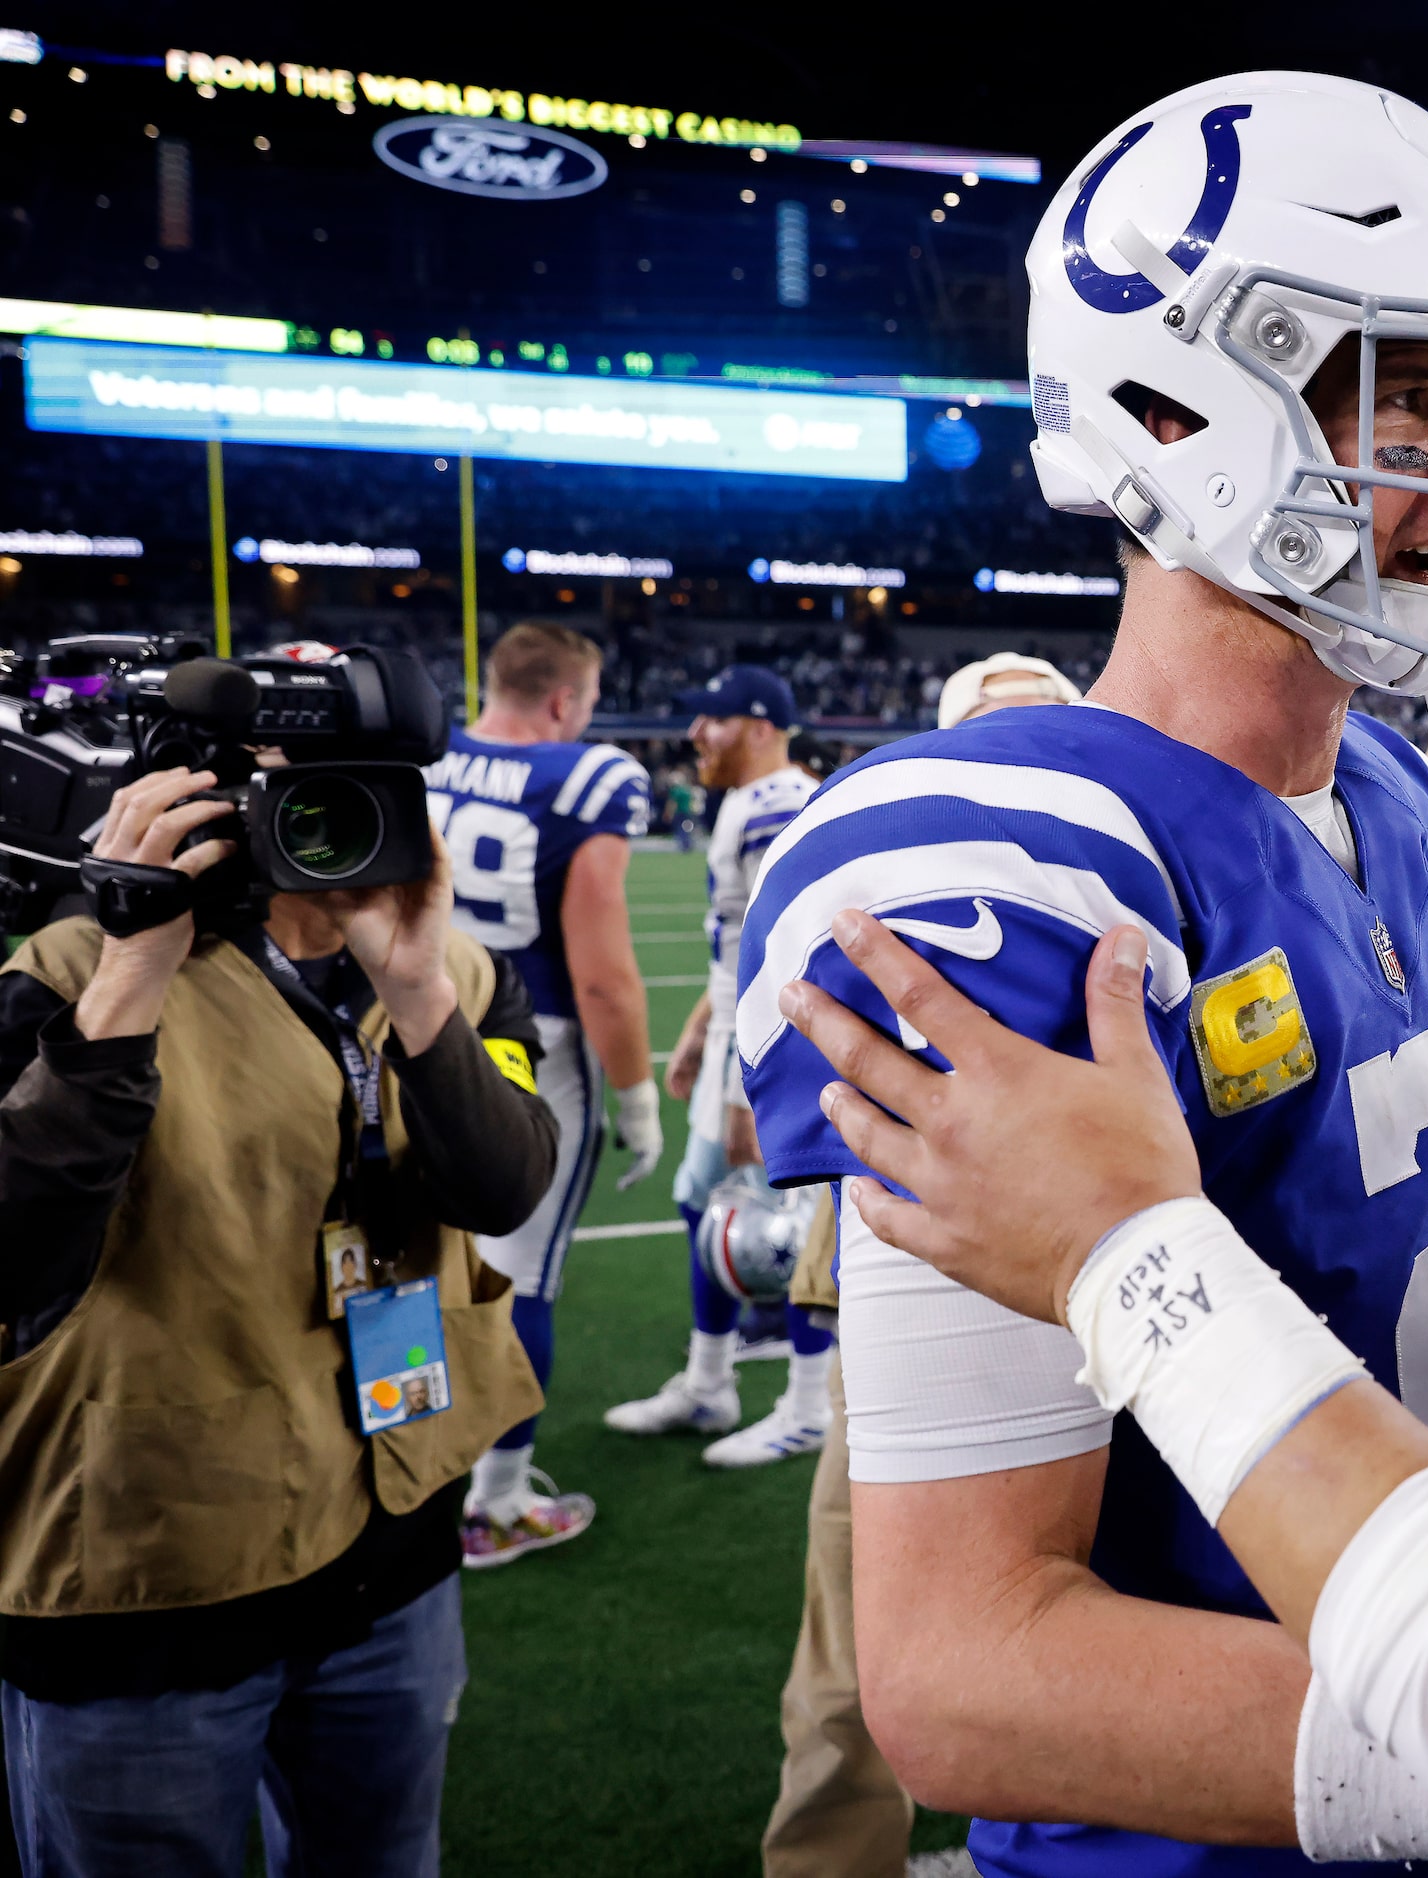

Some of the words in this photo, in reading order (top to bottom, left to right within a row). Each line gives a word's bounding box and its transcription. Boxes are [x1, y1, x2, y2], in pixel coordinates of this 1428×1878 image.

[165, 48, 276, 94] FROM
[279, 62, 356, 102] THE
[358, 71, 526, 122] WORLD'S
[528, 93, 674, 140] BIGGEST
[676, 111, 802, 152] CASINO
[420, 123, 565, 190] Ford
[88, 369, 261, 416] Veterans
[262, 385, 335, 420] and
[1202, 962, 1299, 1077] C
